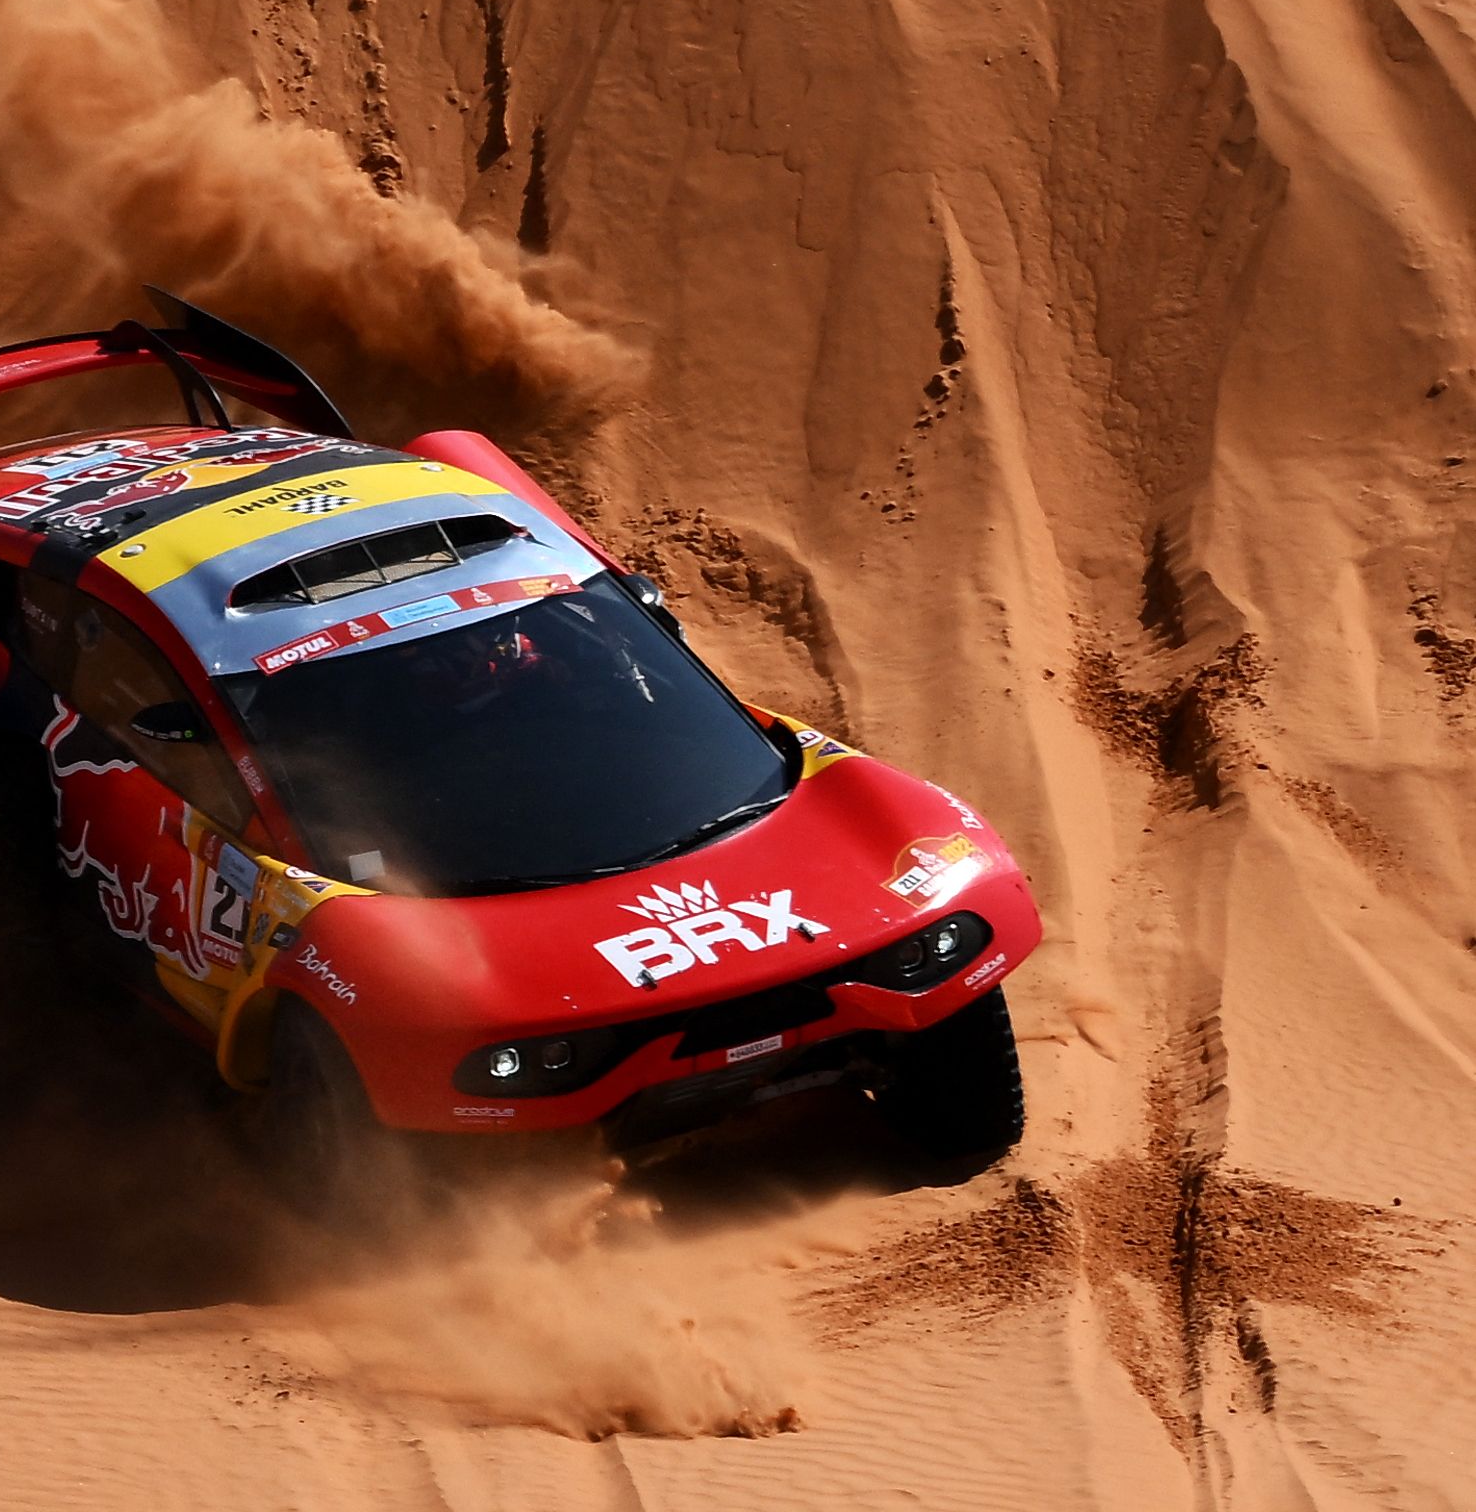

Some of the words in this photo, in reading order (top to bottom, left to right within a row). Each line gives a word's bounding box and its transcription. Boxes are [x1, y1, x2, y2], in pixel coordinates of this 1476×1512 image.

[144, 426, 318, 465] Red
[223, 479, 348, 516] BARDAHL
[265, 637, 333, 670] MOTUL
[898, 874, 921, 890] 211
[202, 939, 240, 965] MOTU
[593, 889, 832, 988] BRX
[296, 944, 358, 1006] Bahrain
